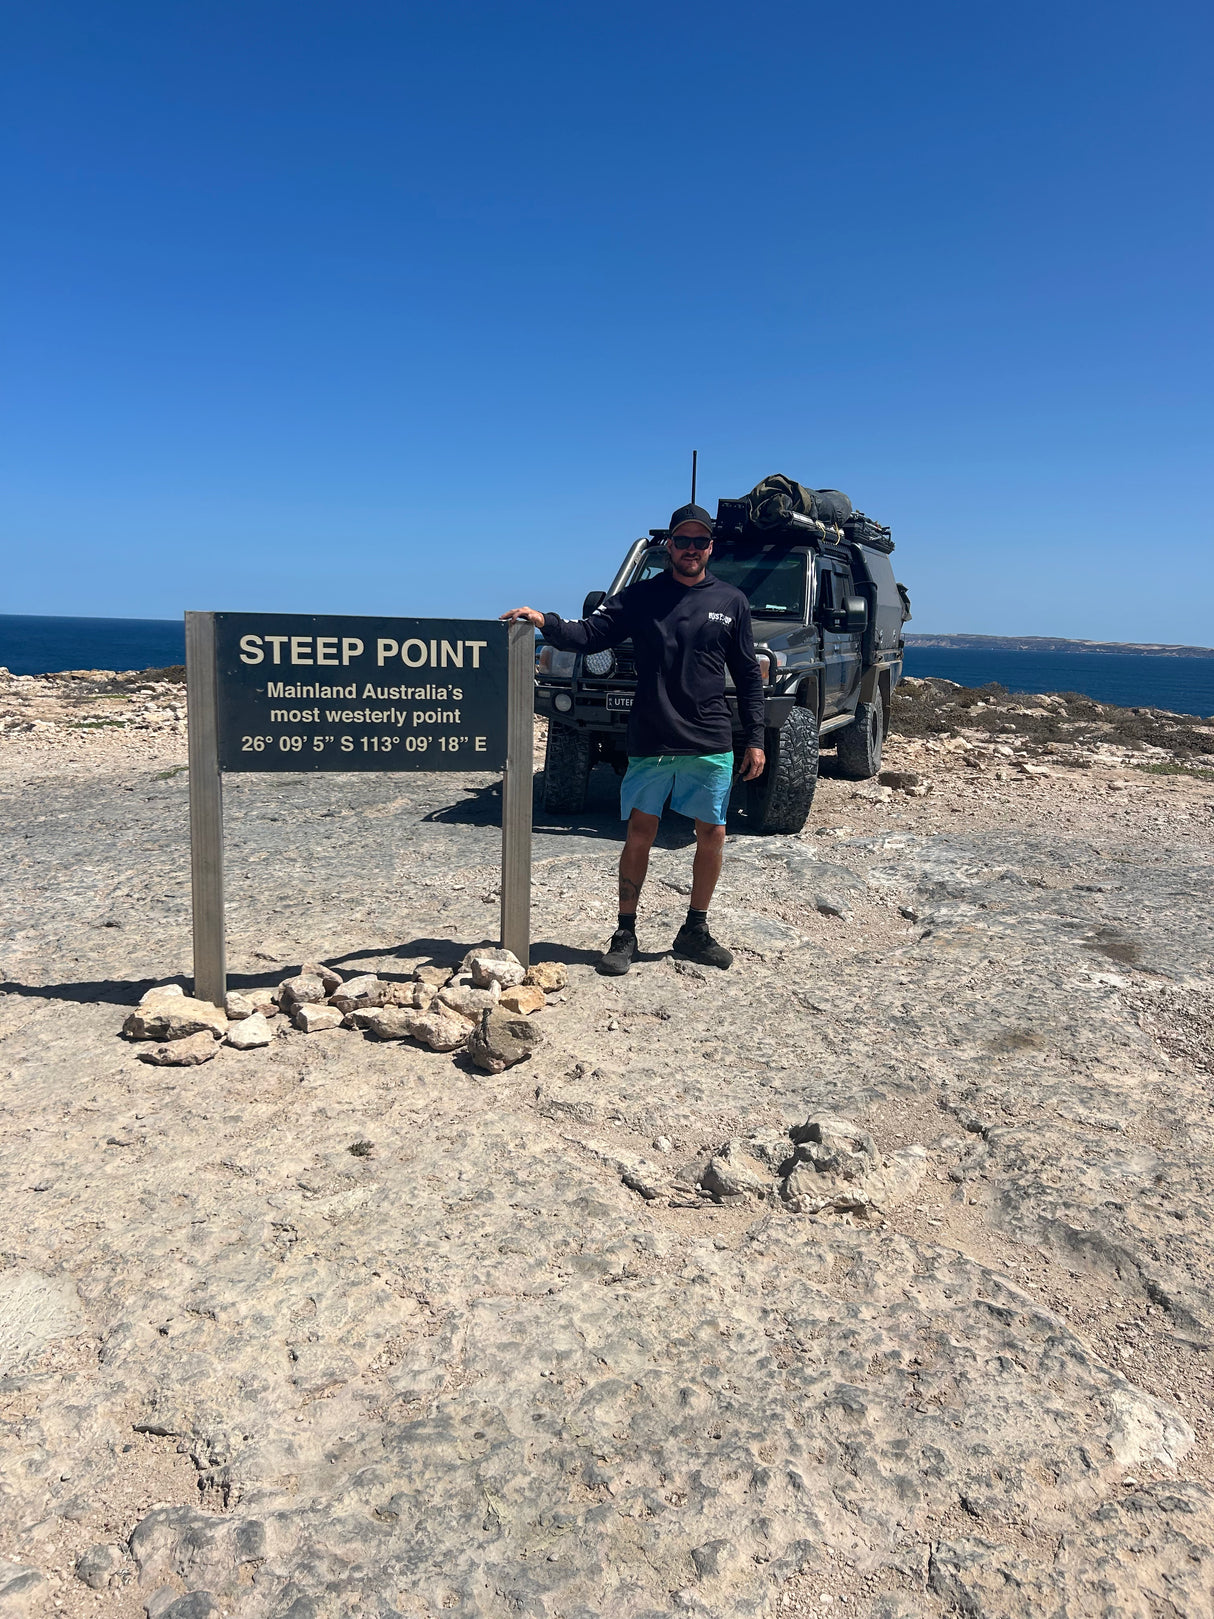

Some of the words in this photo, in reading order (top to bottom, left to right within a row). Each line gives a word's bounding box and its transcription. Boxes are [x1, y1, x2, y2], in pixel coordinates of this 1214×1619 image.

[240, 635, 364, 665] STEEP
[377, 639, 487, 668] POINT
[268, 682, 356, 698] Mainland
[362, 684, 463, 700] Australia’s
[271, 708, 320, 722] most
[326, 708, 407, 727] westerly
[413, 708, 460, 727] point
[242, 736, 273, 751] 26°
[280, 736, 307, 751] 09’
[313, 736, 334, 751] 5”
[341, 736, 354, 751] S
[360, 737, 400, 751] 113°
[406, 737, 432, 751] 09’
[438, 737, 468, 751] 18”
[475, 737, 486, 751] E
